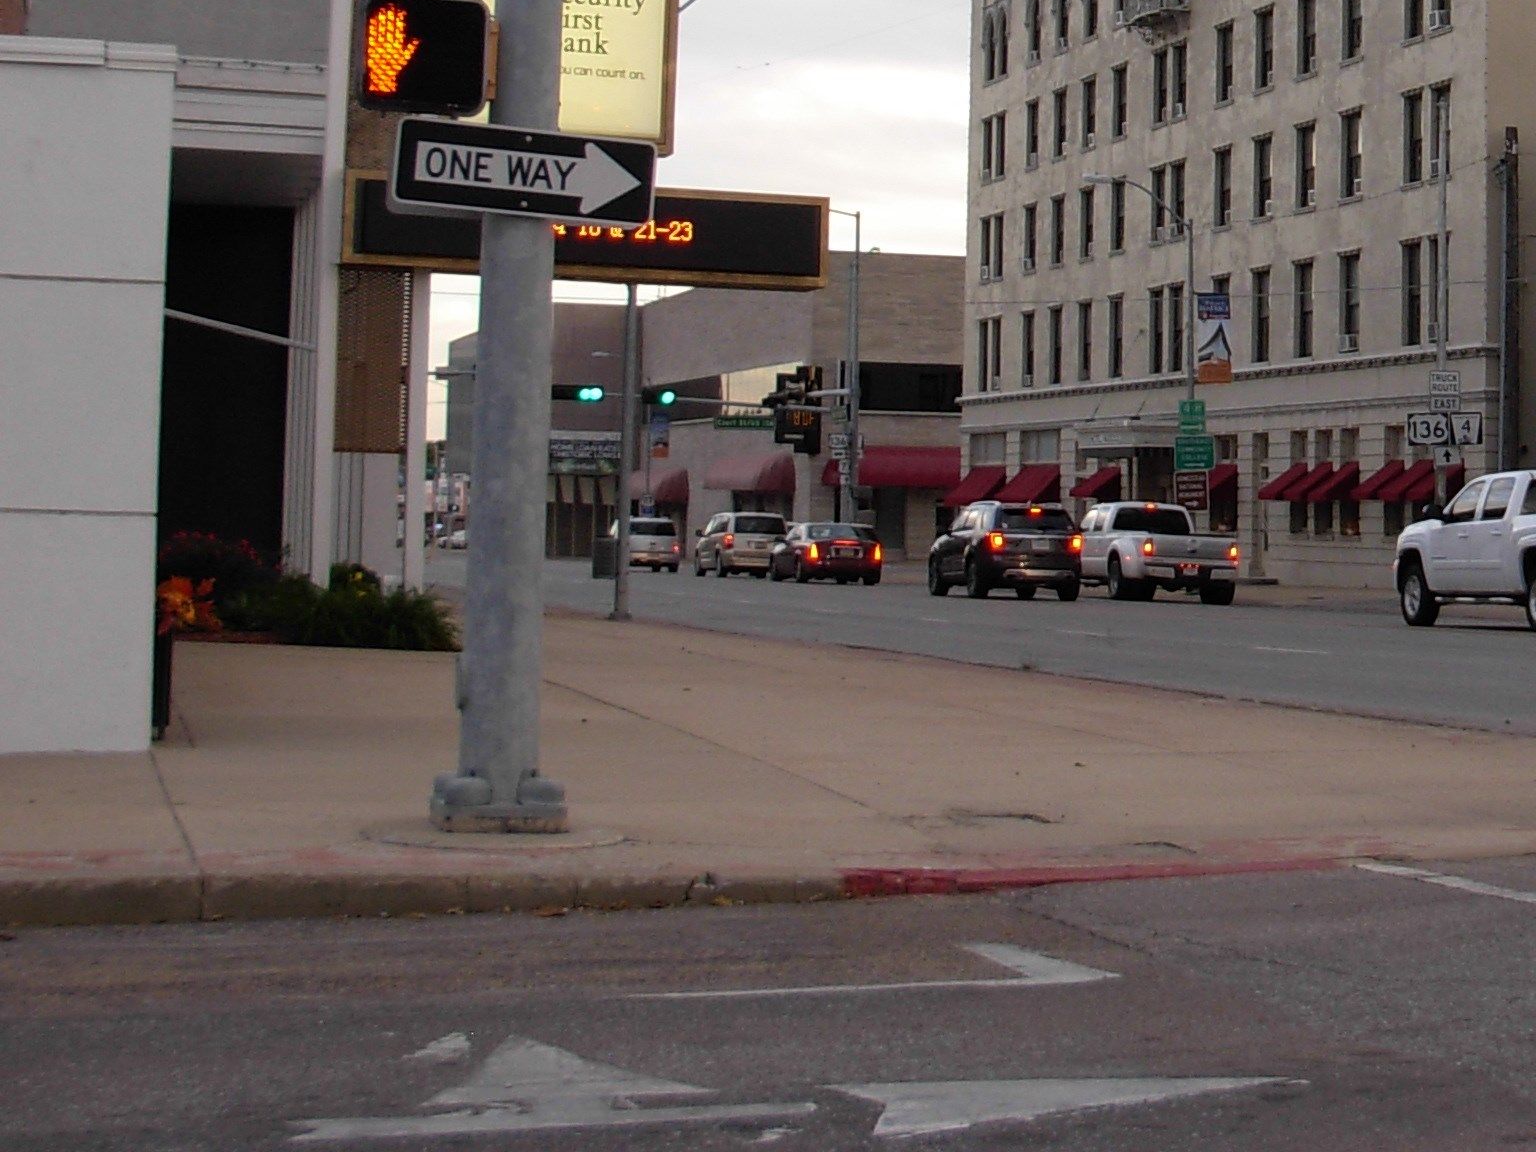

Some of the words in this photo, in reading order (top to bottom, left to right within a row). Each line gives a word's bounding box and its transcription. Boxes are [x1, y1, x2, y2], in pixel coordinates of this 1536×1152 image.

[562, 5, 604, 30] irst
[563, 31, 609, 55] ank
[573, 66, 592, 76] can
[595, 67, 626, 78] count
[425, 146, 494, 184] ONE
[506, 153, 578, 191] WAY
[633, 219, 694, 242] 21-23
[1431, 373, 1458, 382] TRUCK
[1432, 383, 1458, 392] ROUTE
[1434, 398, 1457, 409] EAST
[1411, 420, 1446, 439] 136
[1460, 419, 1471, 433] 4
